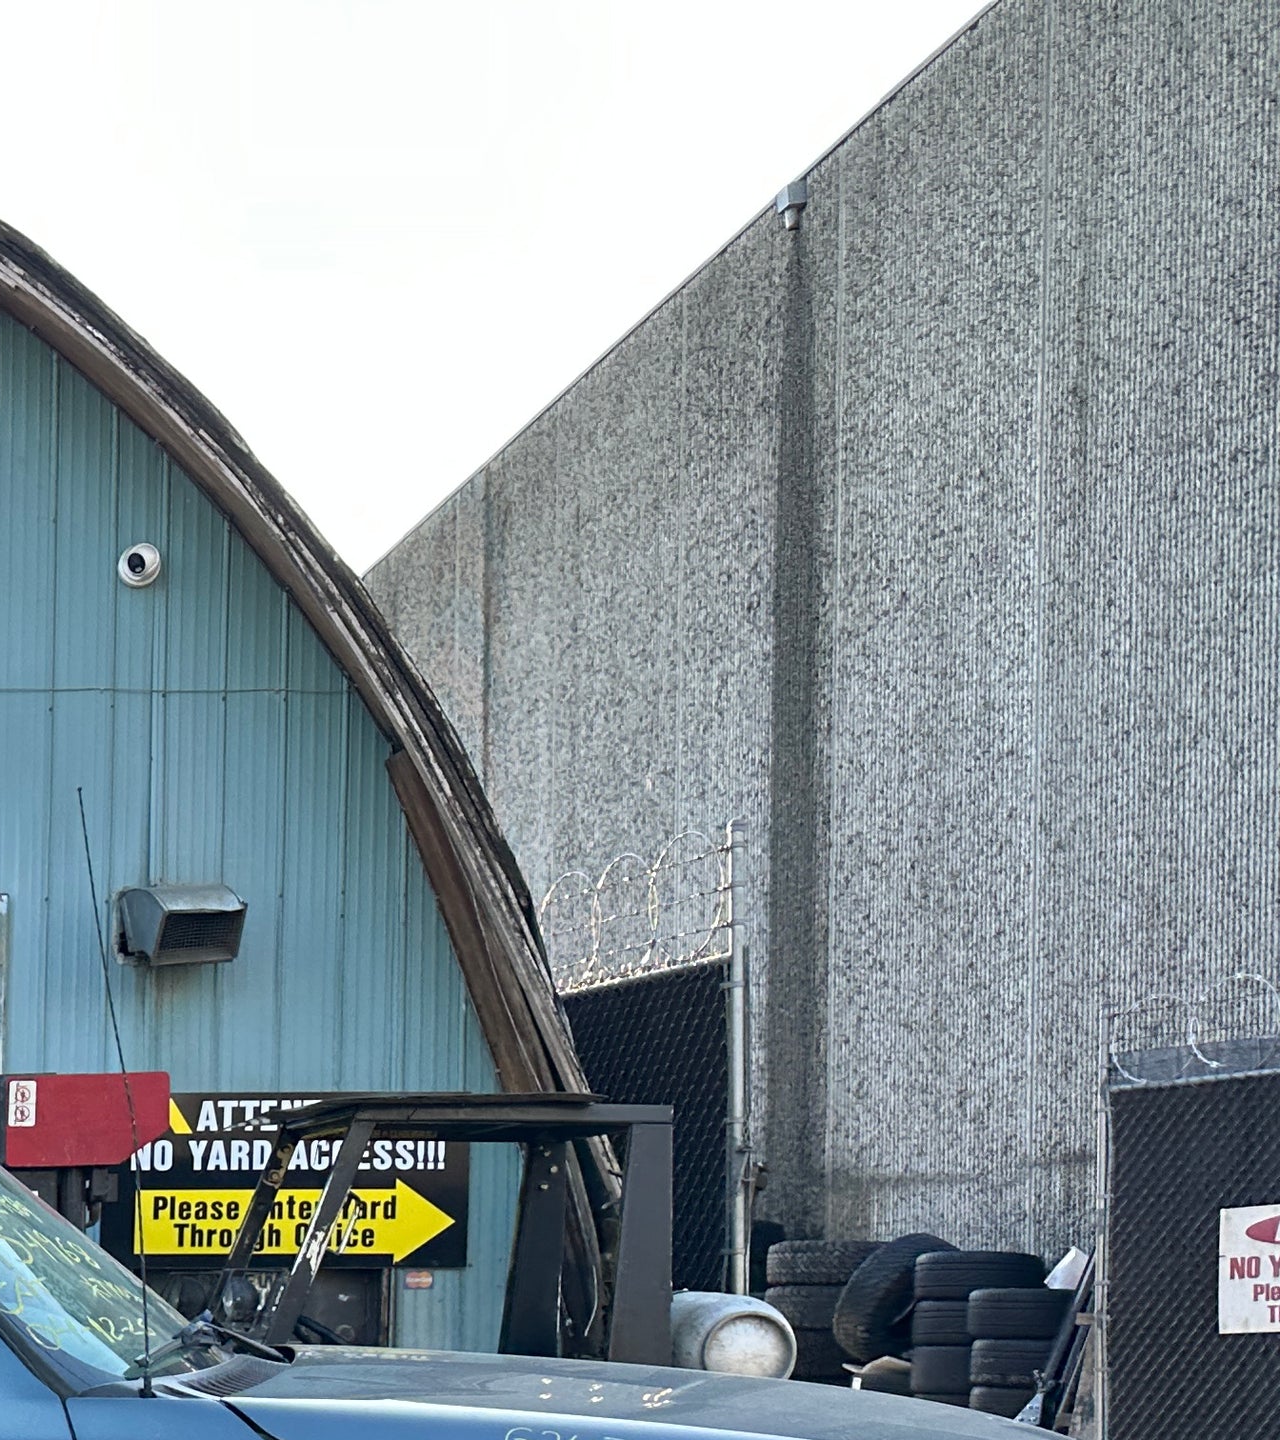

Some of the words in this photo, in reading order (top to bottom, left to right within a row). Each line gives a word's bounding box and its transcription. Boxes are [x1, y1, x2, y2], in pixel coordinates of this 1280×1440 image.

[130, 1140, 173, 1172] NO
[189, 1140, 272, 1172] YARD
[153, 1195, 240, 1220] Please
[173, 1222, 281, 1252] Throgh
[295, 1222, 375, 1248] Oice
[1230, 1256, 1261, 1280] NO
